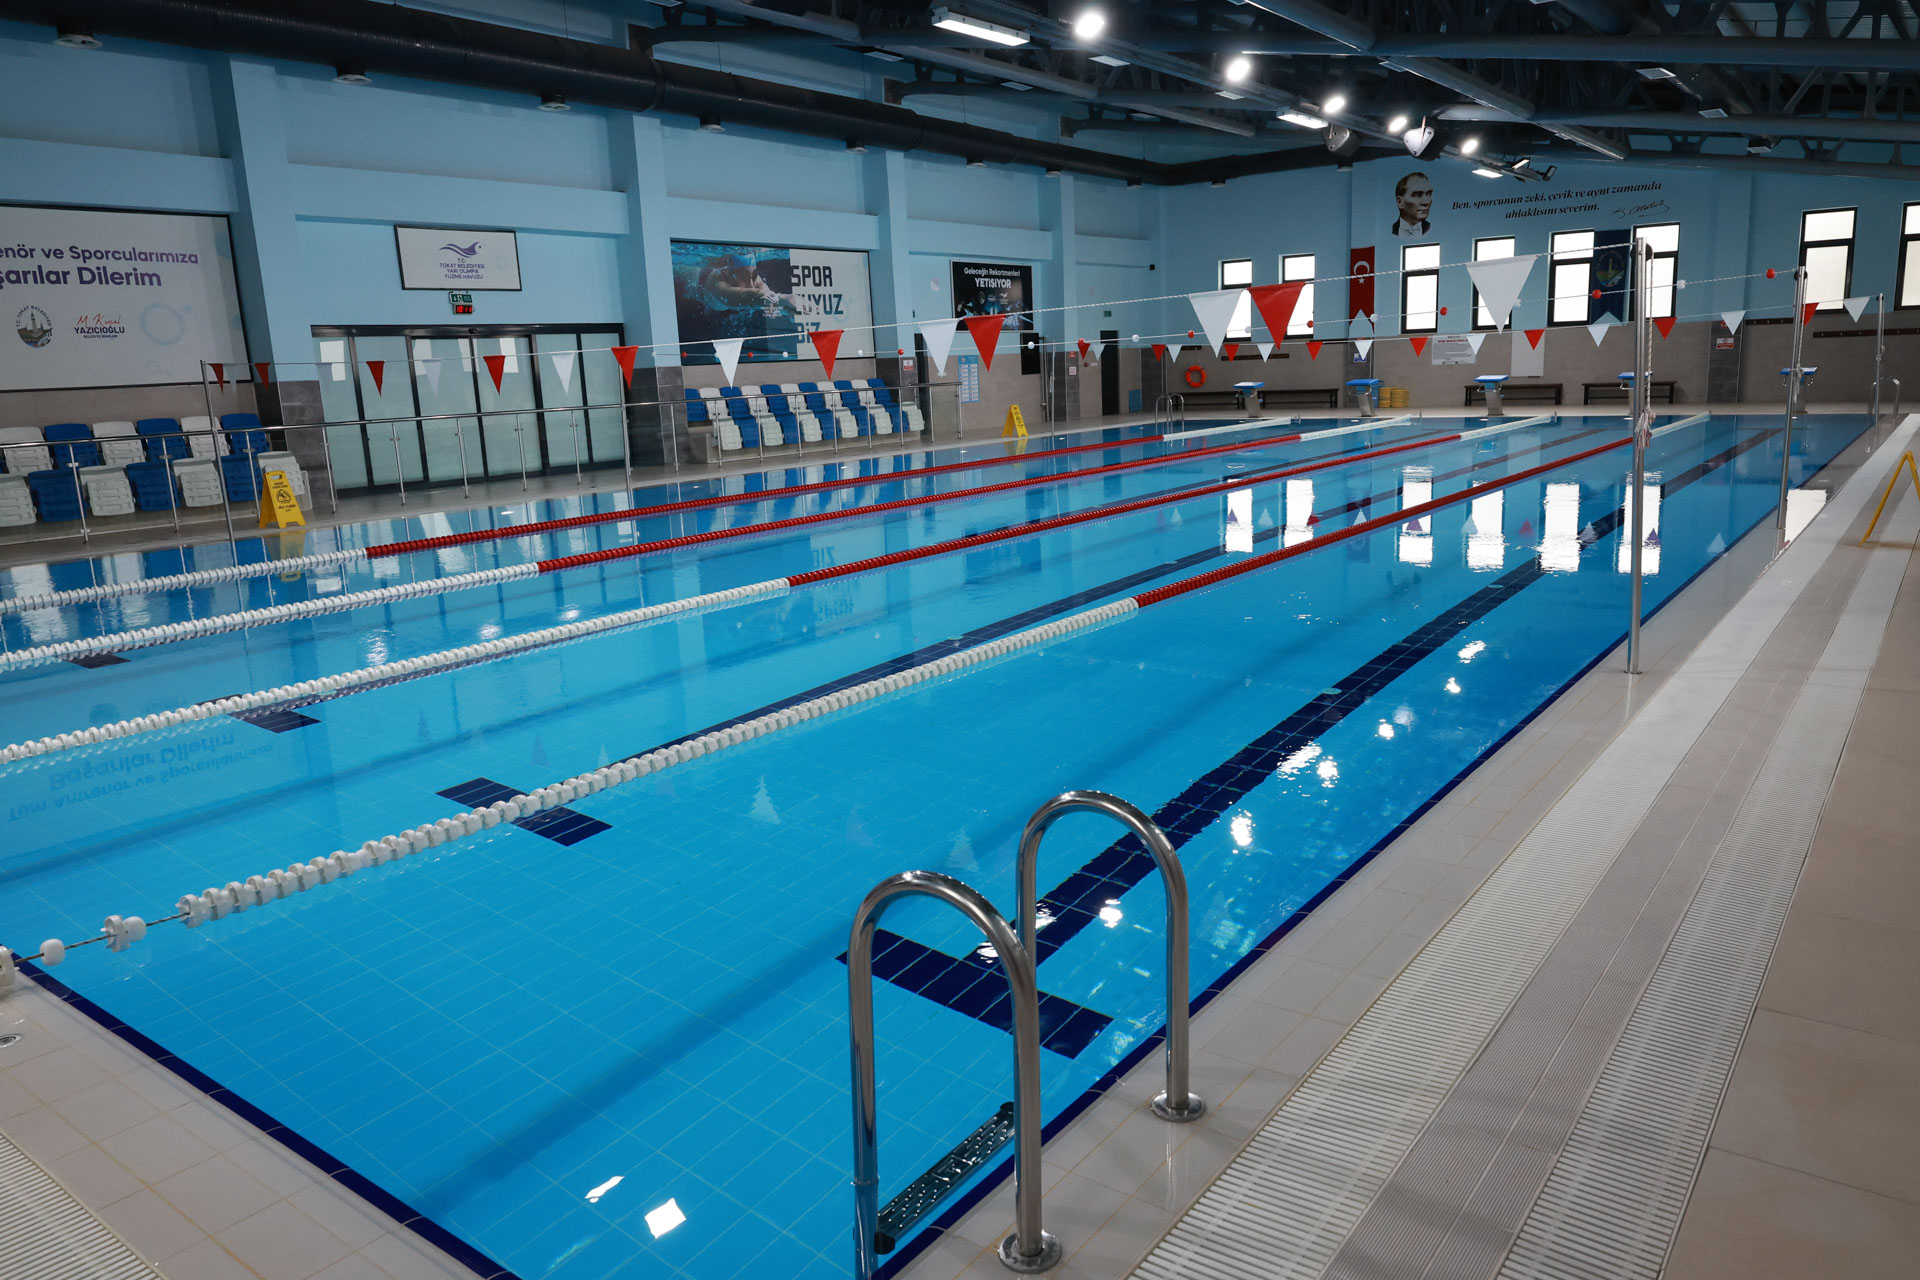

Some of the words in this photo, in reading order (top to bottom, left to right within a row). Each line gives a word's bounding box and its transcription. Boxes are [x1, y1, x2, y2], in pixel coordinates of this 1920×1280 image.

[1473, 197, 1523, 210] sporcunun
[1547, 190, 1573, 202] çevik
[1575, 190, 1585, 198] ve
[1612, 181, 1662, 194] zamanda
[1559, 203, 1600, 215] severim.
[41, 248, 65, 259] ve
[69, 245, 199, 265] Sporcularımıza
[77, 265, 162, 287] Dilerim
[791, 265, 832, 287] SPOR
[964, 267, 988, 276] Geleceğin
[74, 326, 125, 335] YAZICIOĞLU
